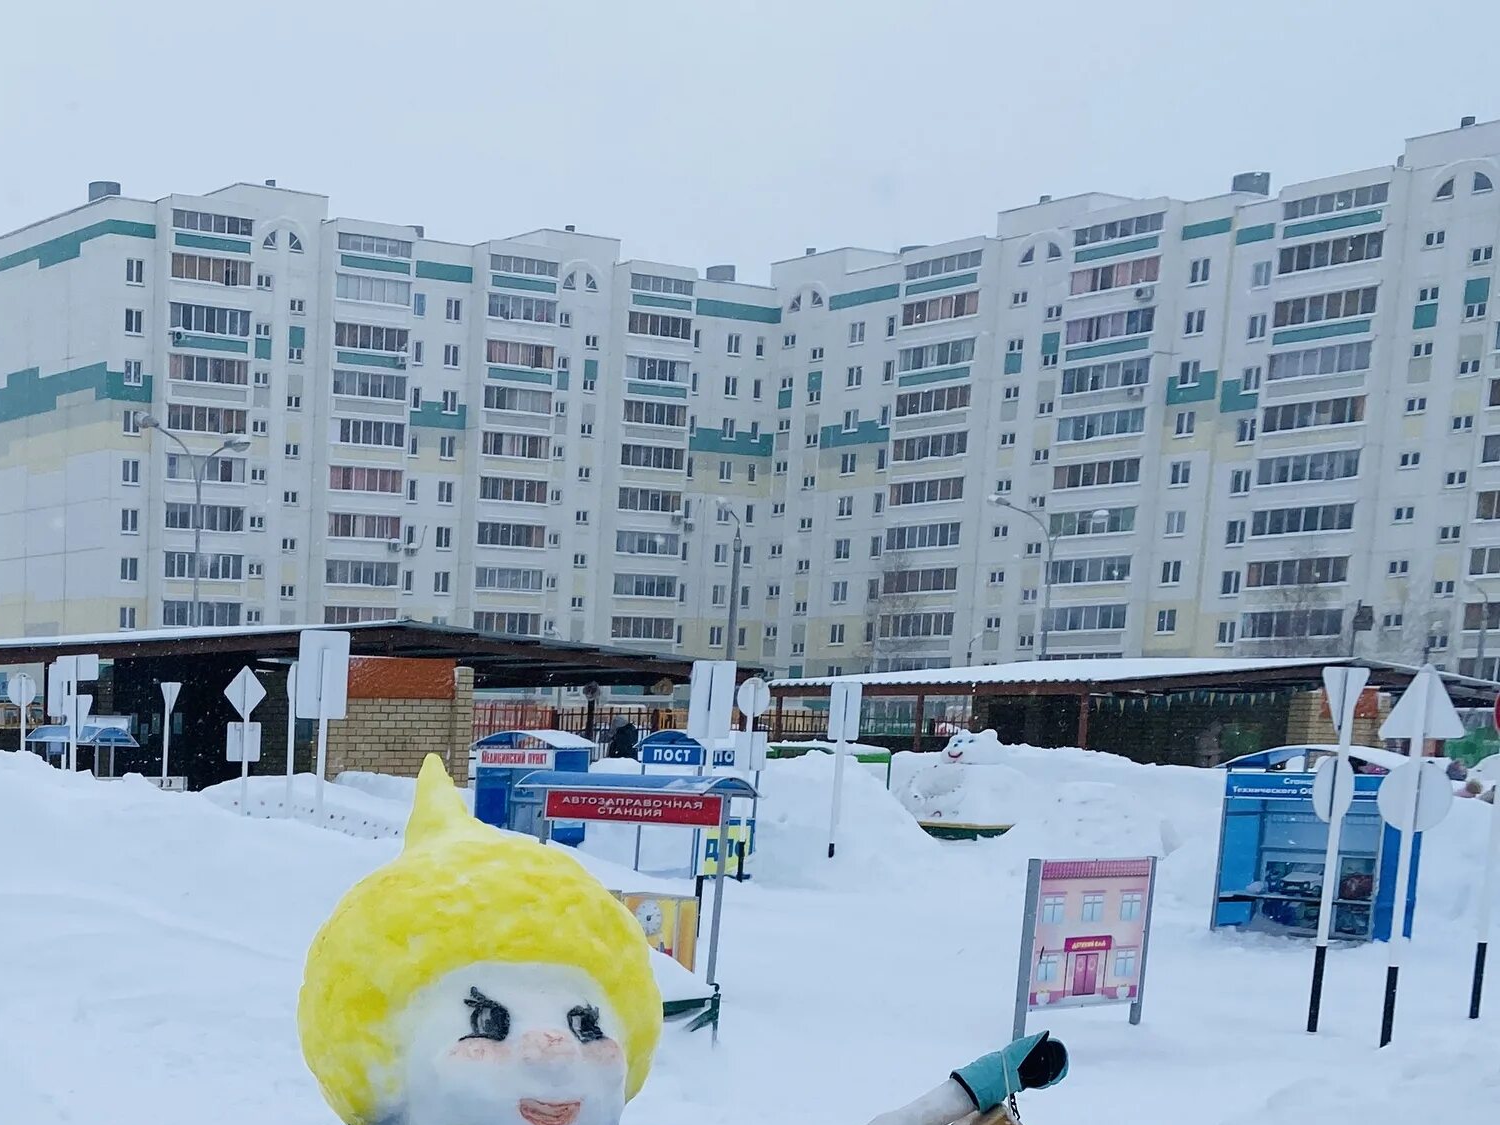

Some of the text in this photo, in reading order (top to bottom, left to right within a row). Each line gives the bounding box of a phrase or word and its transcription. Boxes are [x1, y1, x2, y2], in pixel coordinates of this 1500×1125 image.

[653, 749, 691, 761] ПОСТ
[714, 752, 734, 763] ПО
[561, 796, 703, 810] АВТОЗАПРАВОЧНАЯ
[597, 806, 663, 817] СТАНЦИЯ
